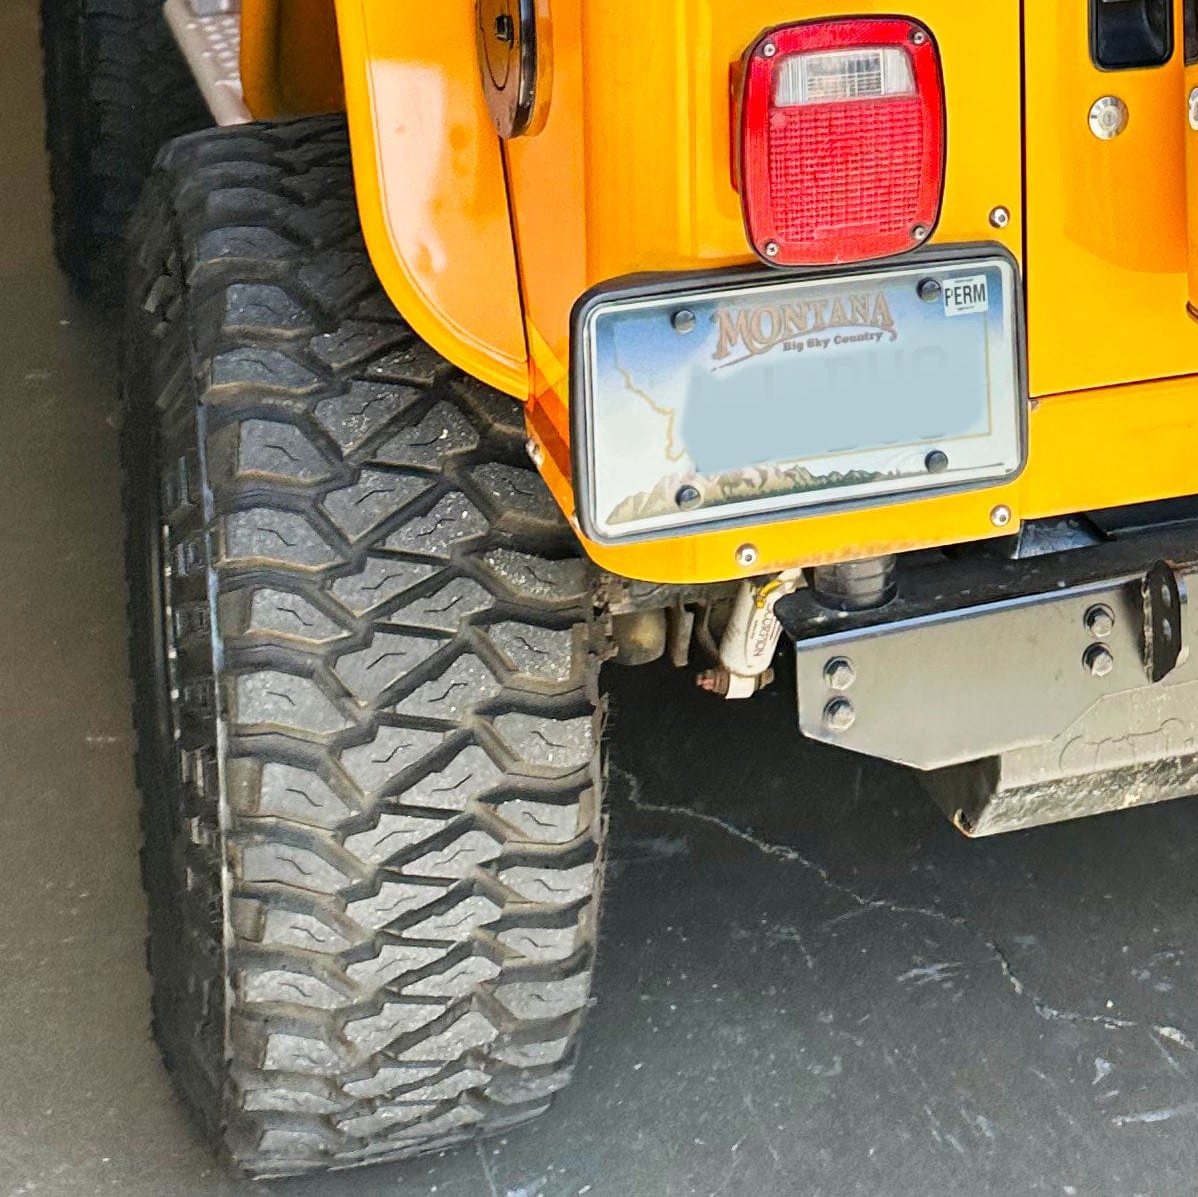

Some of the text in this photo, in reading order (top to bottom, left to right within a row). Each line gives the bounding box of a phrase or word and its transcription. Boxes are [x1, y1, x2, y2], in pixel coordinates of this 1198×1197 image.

[944, 283, 986, 306] PERM
[711, 290, 896, 361] MONTANA
[782, 331, 884, 352] Big Sky Country
